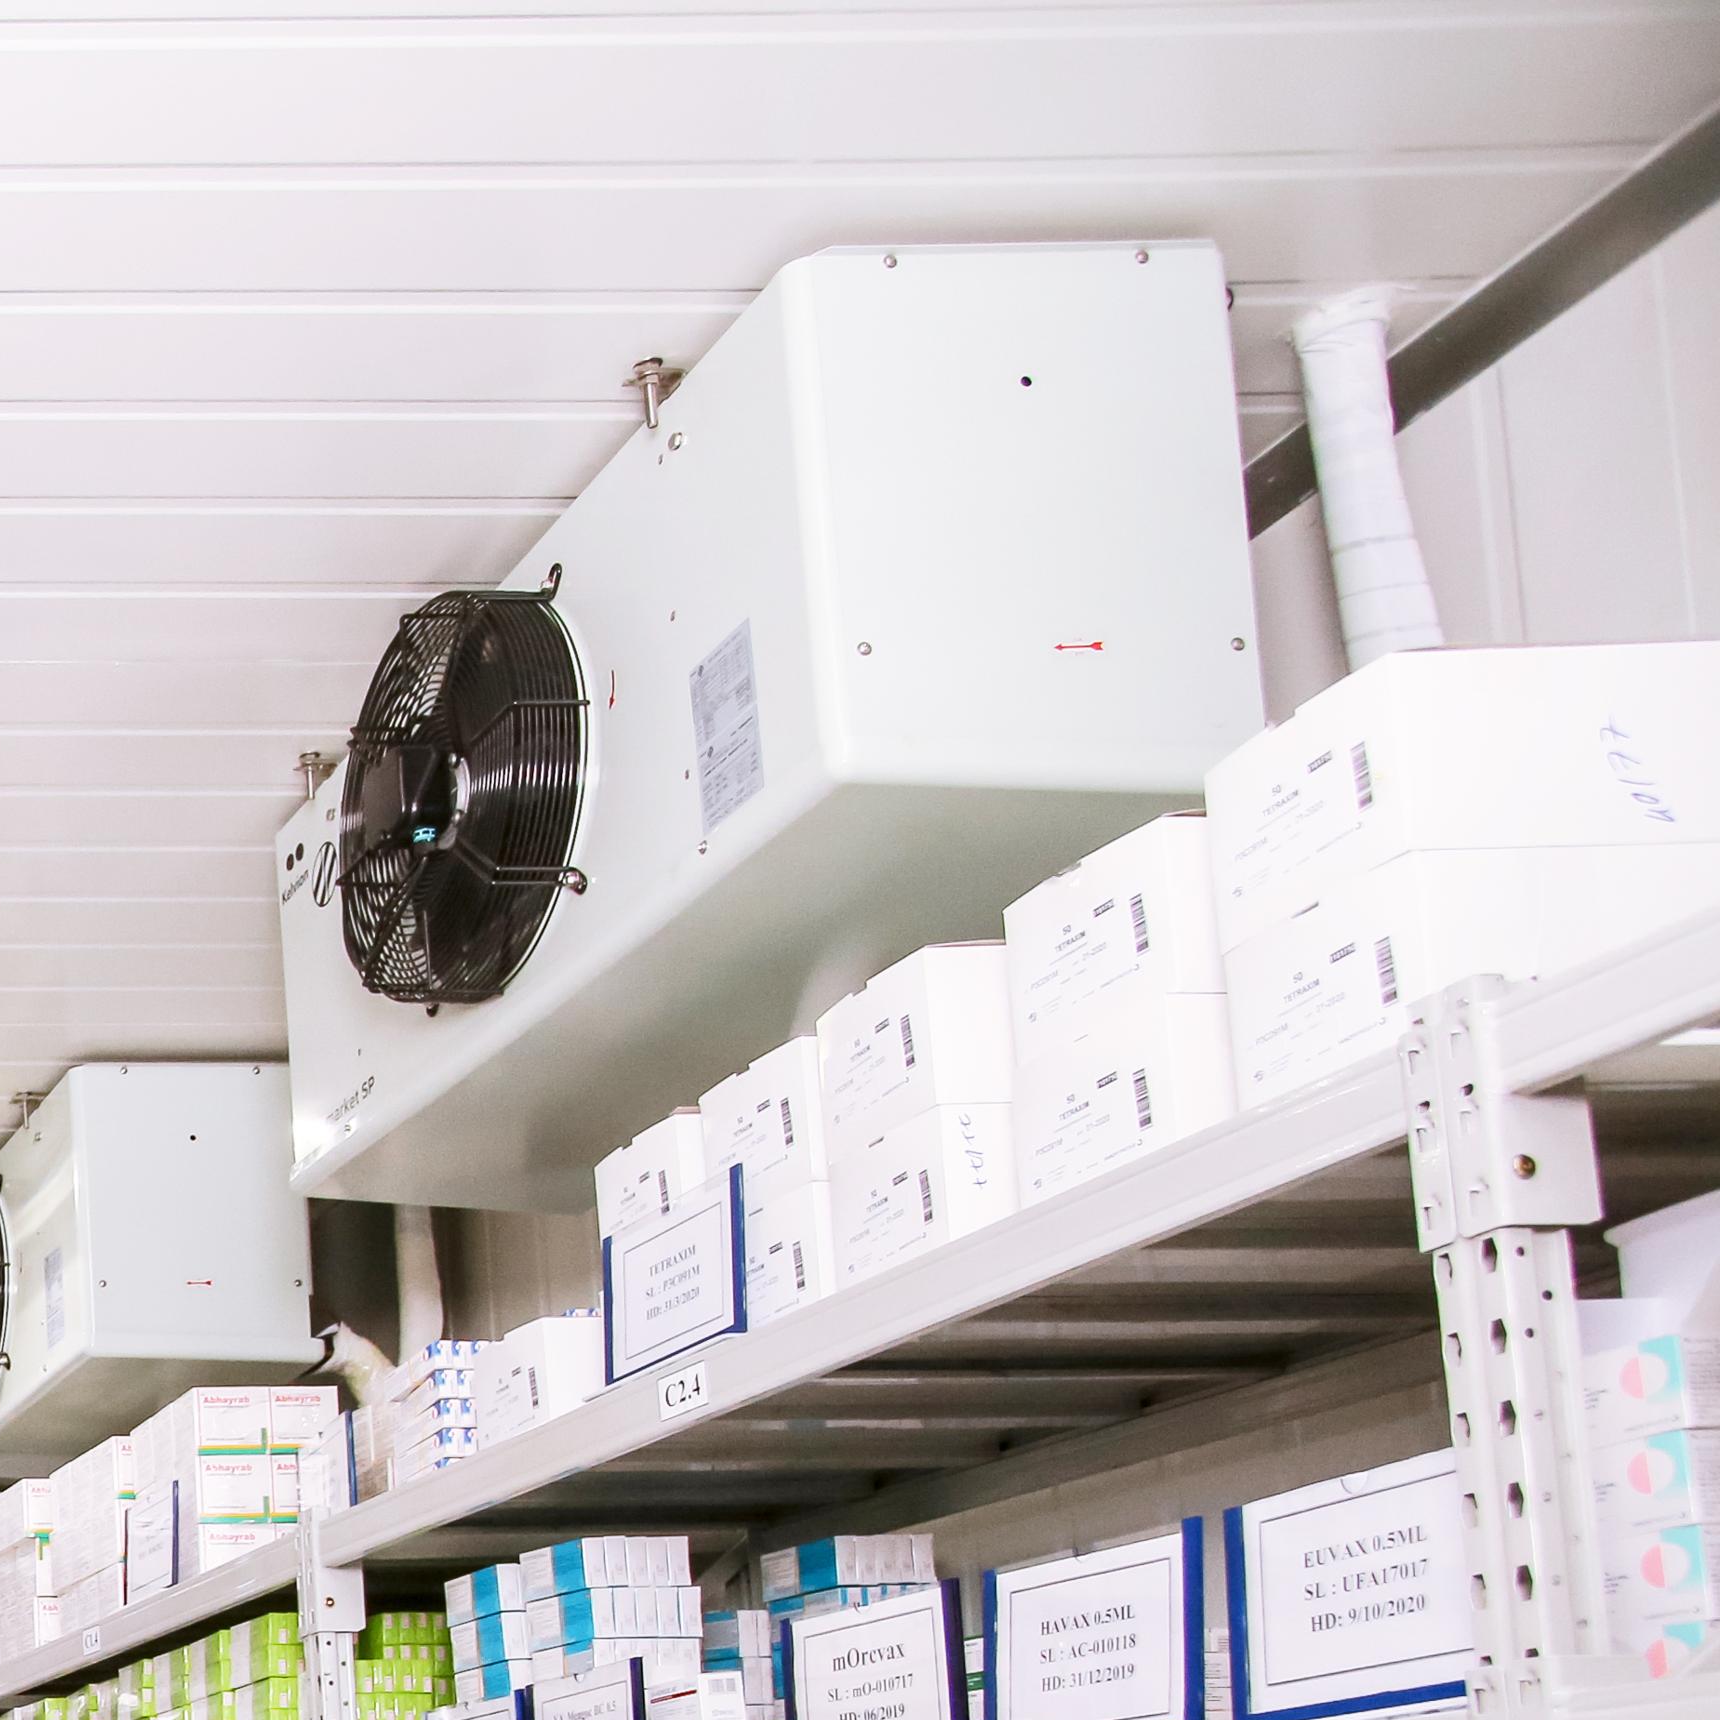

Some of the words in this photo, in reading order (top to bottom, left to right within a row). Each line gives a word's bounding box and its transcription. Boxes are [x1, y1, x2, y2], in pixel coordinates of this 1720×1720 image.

[1262, 790, 1299, 817] TETRAXIM
[282, 869, 309, 905] Kelvion
[1054, 931, 1086, 952] TETRAXIM
[1283, 978, 1321, 1003] TETRAXIM
[361, 1075, 375, 1101] SP
[649, 1243, 697, 1278] TETRAXIM
[645, 1303, 663, 1321] HD:
[203, 1395, 250, 1406] Abhayrab
[274, 1394, 322, 1405] Abhayrab
[665, 1373, 700, 1407] C2.4
[205, 1463, 253, 1474] Abhayrab
[209, 1532, 256, 1543] Abhayrab
[1303, 1539, 1369, 1569] EUVAX
[1372, 1525, 1428, 1552] 0.5ML
[1303, 1582, 1326, 1601] SL
[1342, 1557, 1429, 1594] UFA17017
[1040, 1611, 1091, 1636] HAVAX
[1093, 1604, 1136, 1626] 0.5ML
[1310, 1612, 1344, 1633] HD:
[1347, 1593, 1426, 1623] 9/10/2020
[832, 1643, 906, 1673] mOrcvax
[1040, 1648, 1056, 1664] SL
[1070, 1633, 1137, 1660] AC-010118
[827, 1687, 842, 1704] SL
[852, 1672, 914, 1699] mO-010717
[1041, 1676, 1067, 1693] HD:
[1068, 1662, 1135, 1688] 31/12/2019
